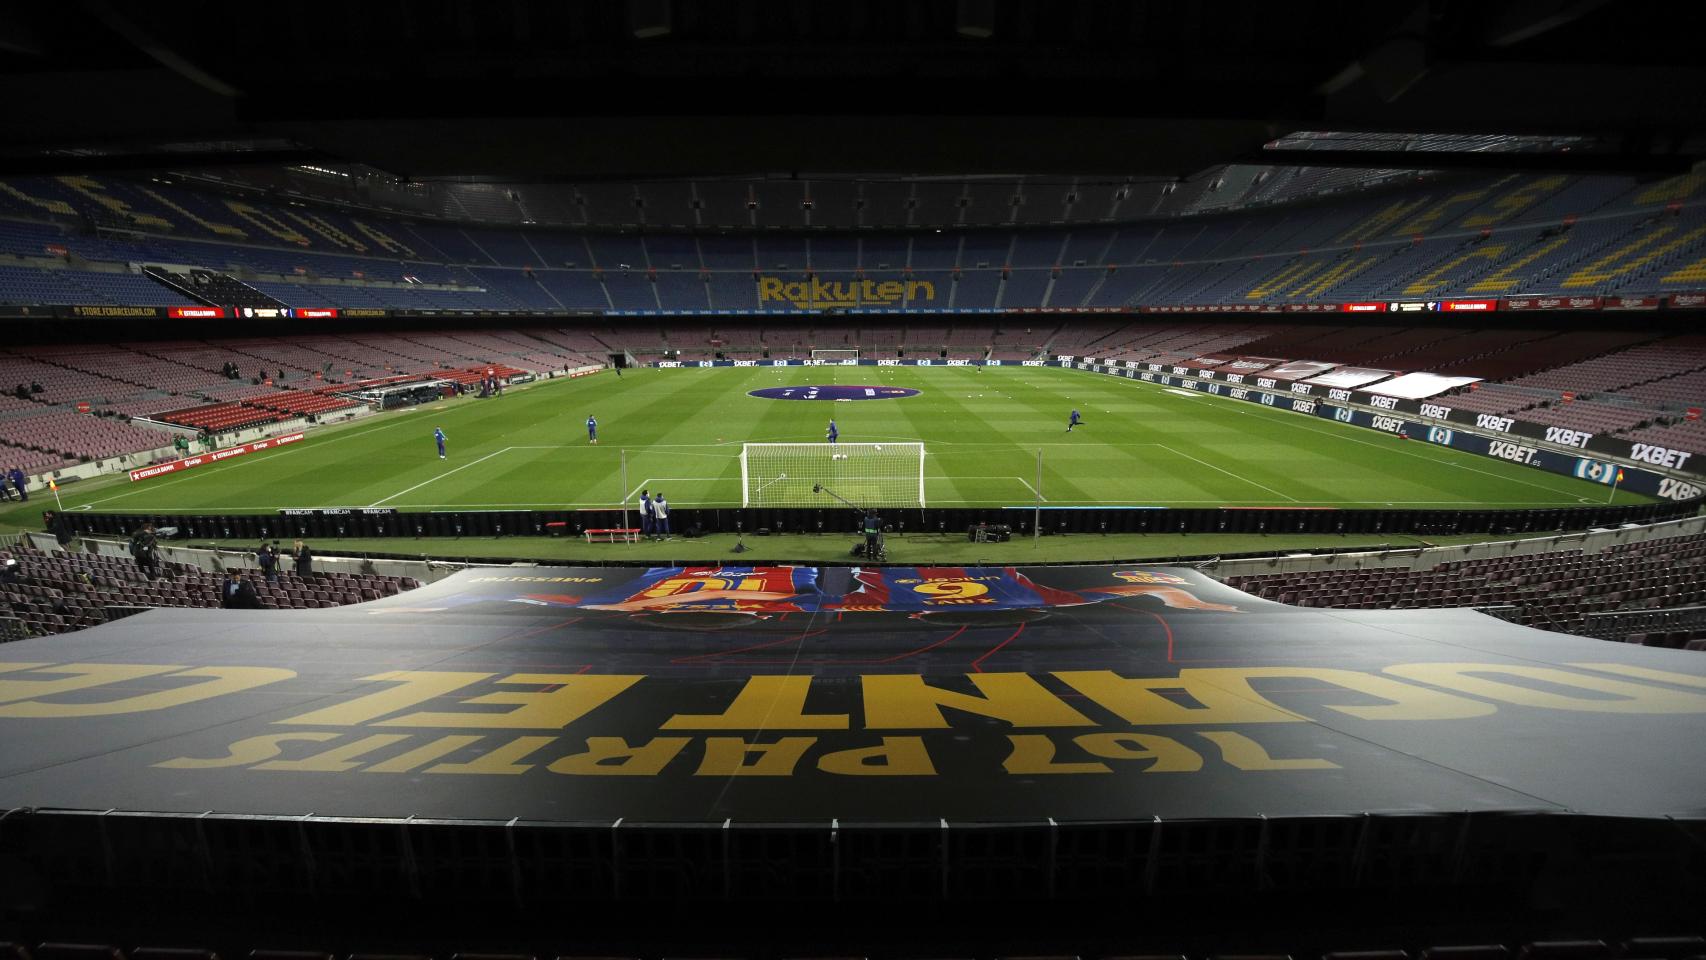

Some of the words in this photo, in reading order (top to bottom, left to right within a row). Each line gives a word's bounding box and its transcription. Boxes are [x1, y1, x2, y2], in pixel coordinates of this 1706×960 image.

[760, 277, 935, 309] Rakuten
[1257, 378, 1277, 388] 1XBET
[1291, 382, 1312, 394] 1XBET
[1329, 388, 1352, 402] 1XBET
[1370, 395, 1398, 410] 1XBET
[1420, 404, 1451, 420] 1XBET
[1476, 413, 1515, 433] 1XBET
[1546, 426, 1593, 449] 1XBET
[217, 450, 234, 458] ESTRELLA
[1489, 440, 1540, 467] 1XBET.es
[1631, 443, 1692, 470] 1XBET
[140, 467, 161, 478] ESTRELLA
[161, 464, 174, 474] DAMM
[912, 581, 989, 600] 6
[0, 662, 298, 718] CE
[269, 671, 648, 729] EL
[659, 662, 1706, 730] OCANT
[149, 732, 938, 776] PARTITS
[1003, 731, 1343, 775] 767
